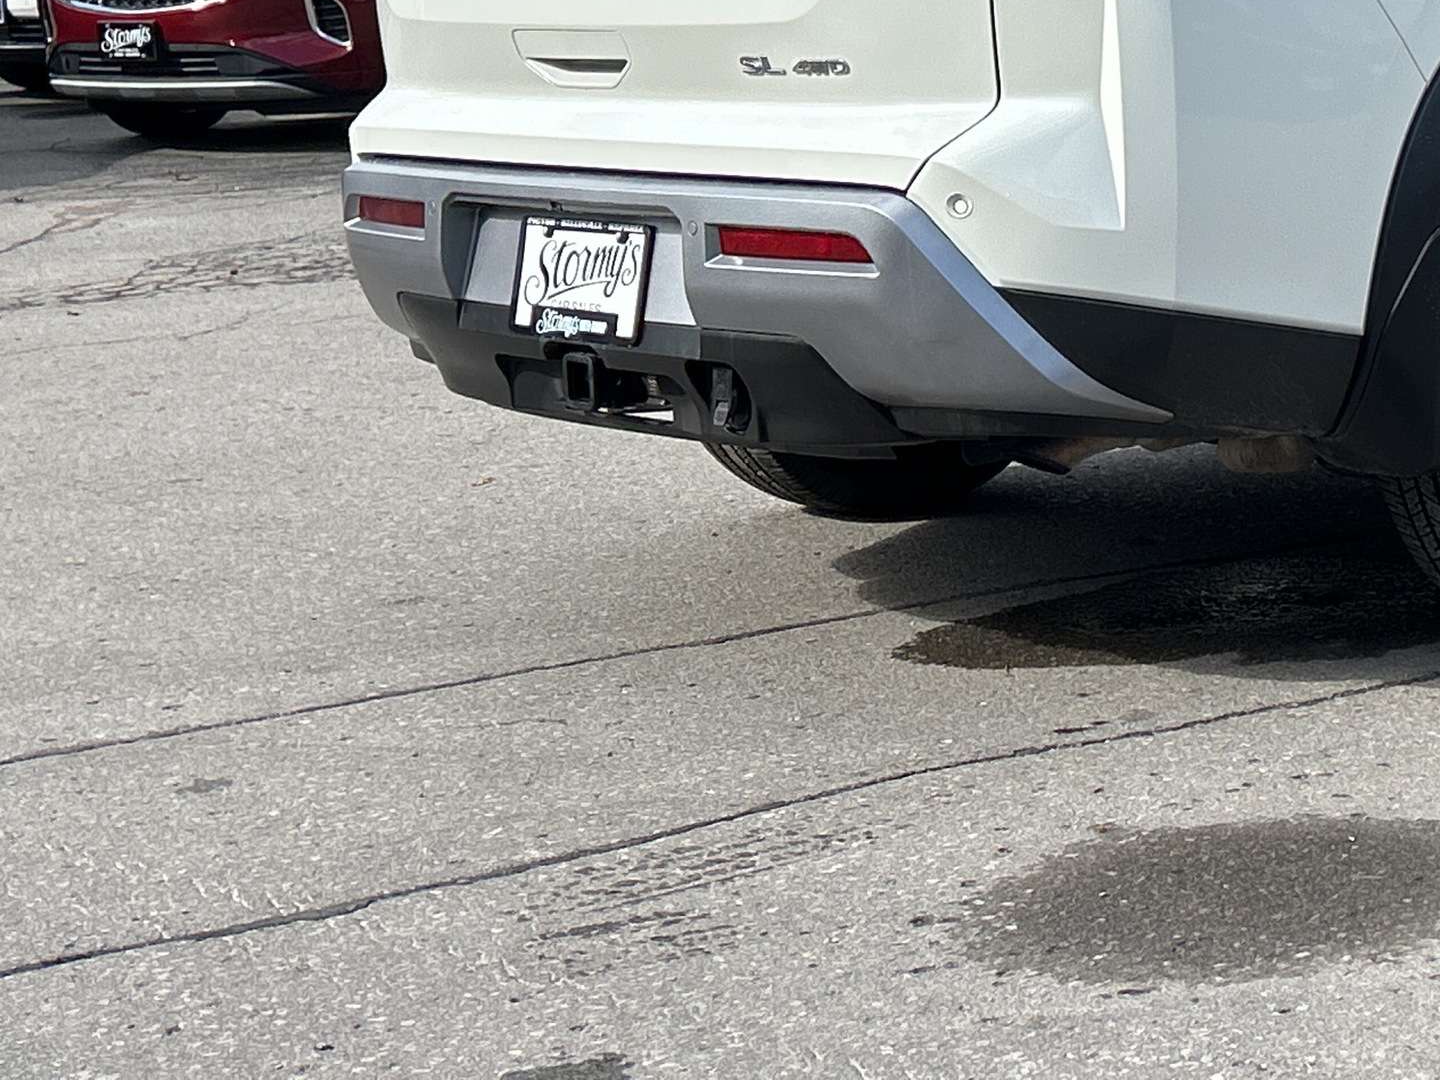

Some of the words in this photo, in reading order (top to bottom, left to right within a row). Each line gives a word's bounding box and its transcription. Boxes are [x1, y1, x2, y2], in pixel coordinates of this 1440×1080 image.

[740, 56, 787, 76] SL
[792, 60, 850, 76] 4WD
[524, 240, 641, 306] Stormy's
